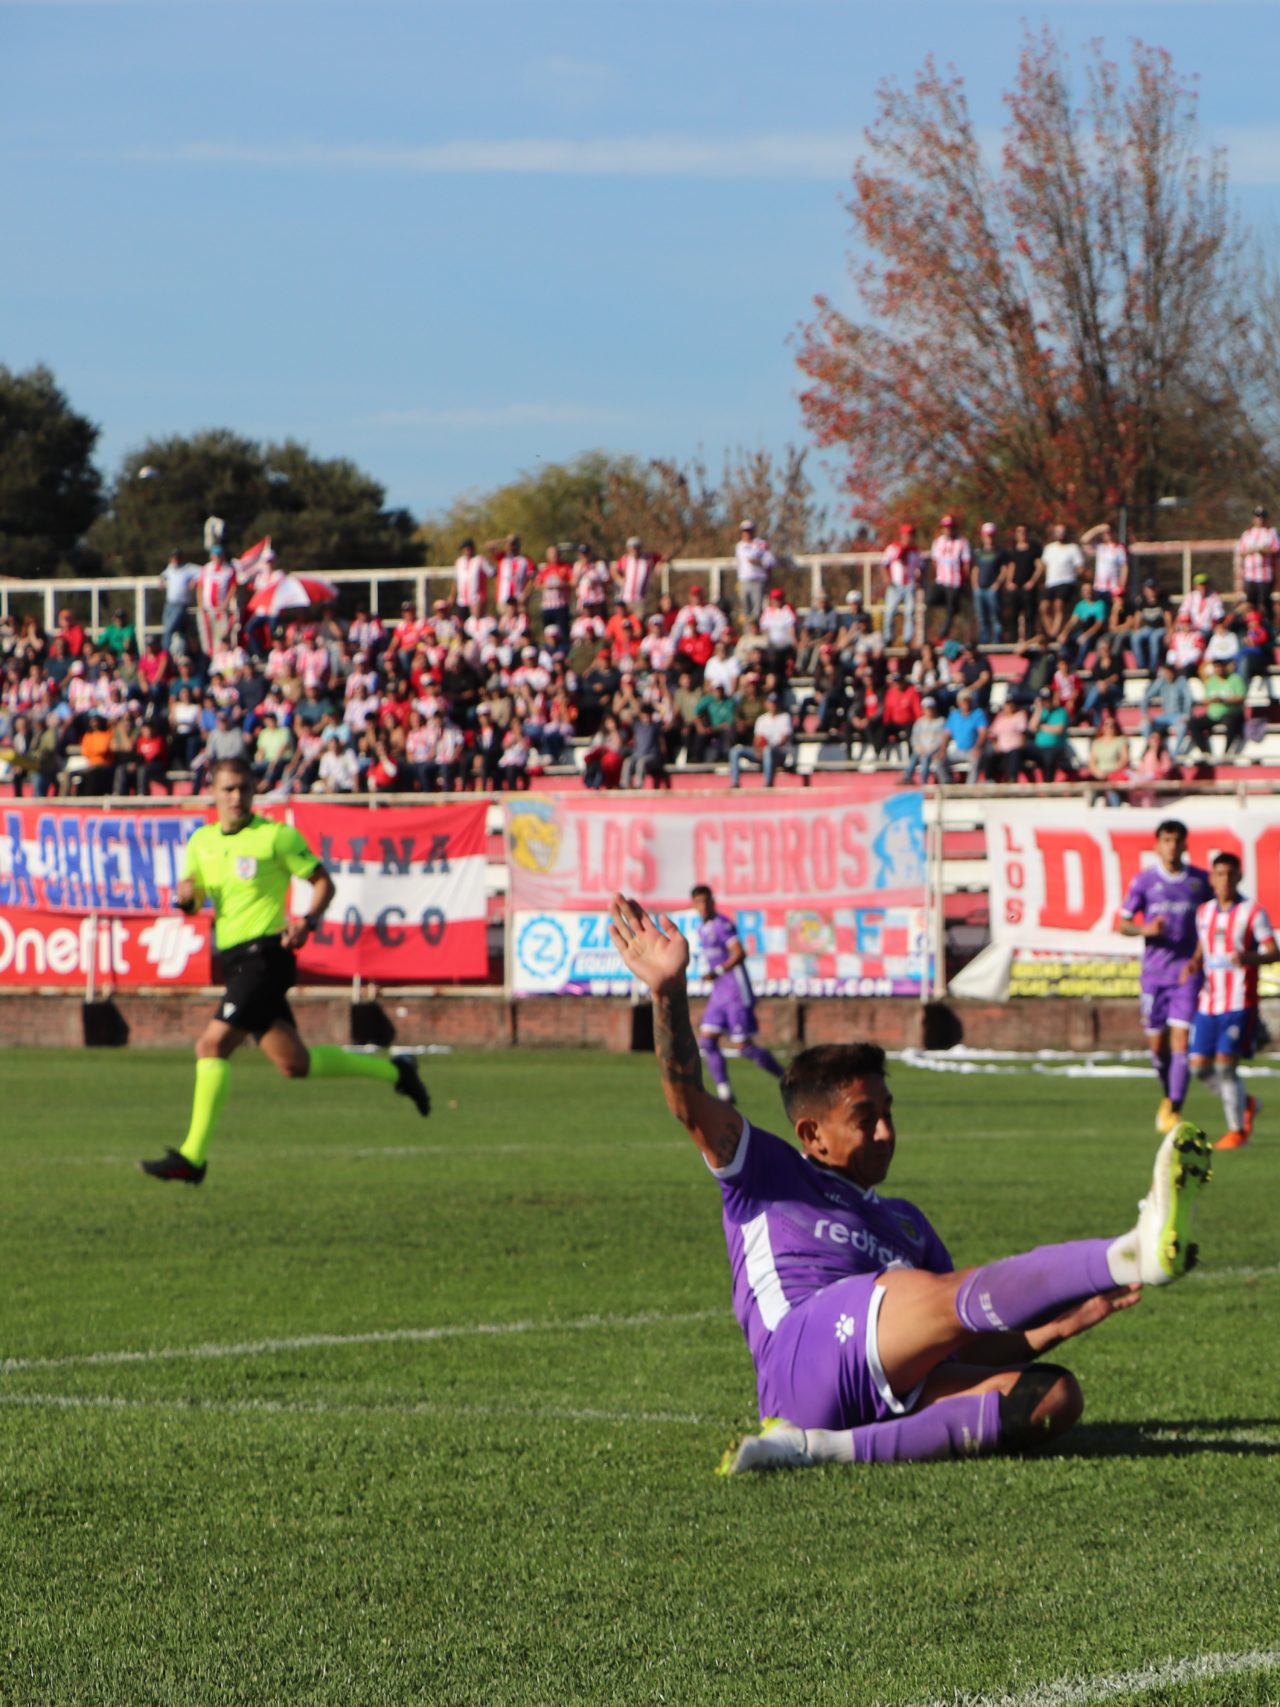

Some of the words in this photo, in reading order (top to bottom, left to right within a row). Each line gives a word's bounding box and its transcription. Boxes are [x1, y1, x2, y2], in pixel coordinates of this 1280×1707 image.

[0, 816, 37, 906] A
[38, 822, 214, 911] ORIENT
[320, 834, 451, 874] LINA
[576, 818, 657, 893] LOS
[694, 812, 871, 895] CEDROS
[1003, 823, 1025, 925] LOS
[0, 915, 131, 974] nefit
[314, 905, 446, 947] LOCO
